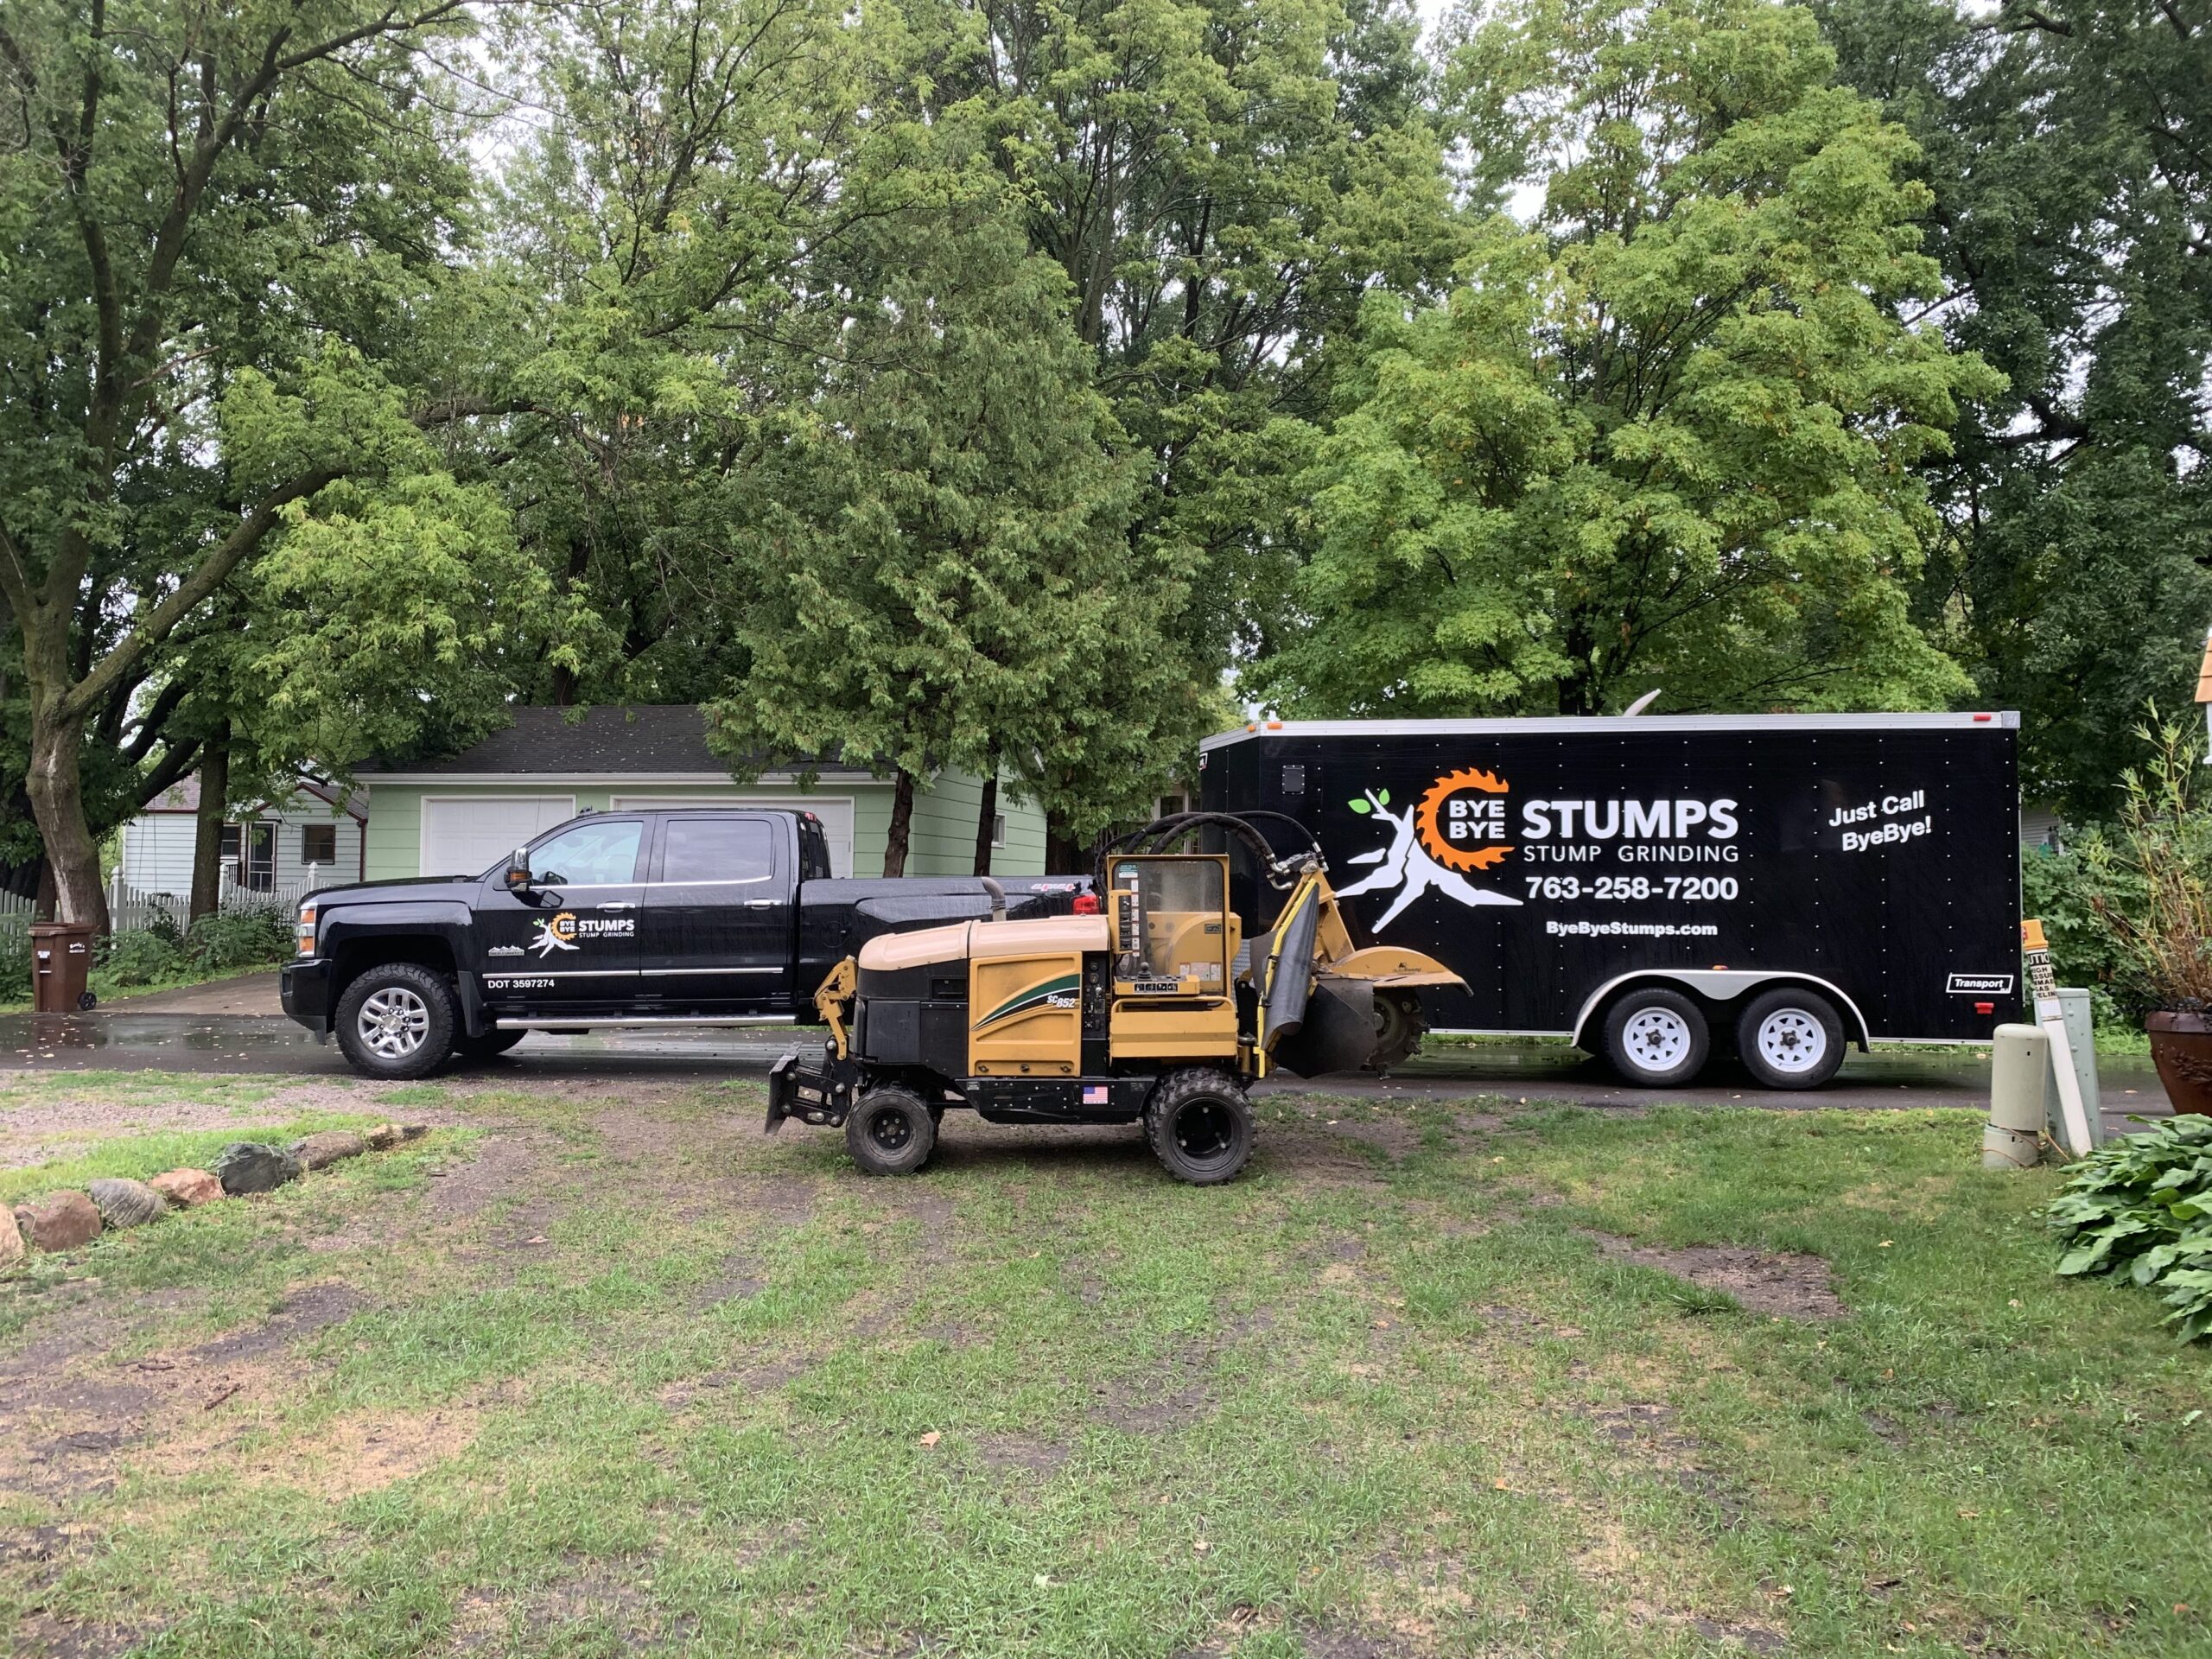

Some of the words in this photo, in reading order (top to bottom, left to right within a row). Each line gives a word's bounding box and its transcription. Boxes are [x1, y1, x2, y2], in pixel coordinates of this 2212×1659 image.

[1449, 800, 1505, 818] BYE
[1828, 802, 1877, 827] Just
[1882, 790, 1924, 814] Call
[1522, 799, 1738, 839] STUMPS
[1449, 821, 1505, 839] BYE
[1842, 816, 1932, 852] ByeBye!
[1524, 845, 1602, 862] STUMP
[1618, 845, 1738, 862] GRINDING
[1525, 876, 1738, 899] 763-258-7200
[578, 919, 635, 931] STUMPS
[1546, 920, 1718, 936] ByeByeStumps.com
[487, 979, 510, 988] DOT
[512, 978, 556, 988] 3597274
[1955, 978, 2004, 989] Transport
